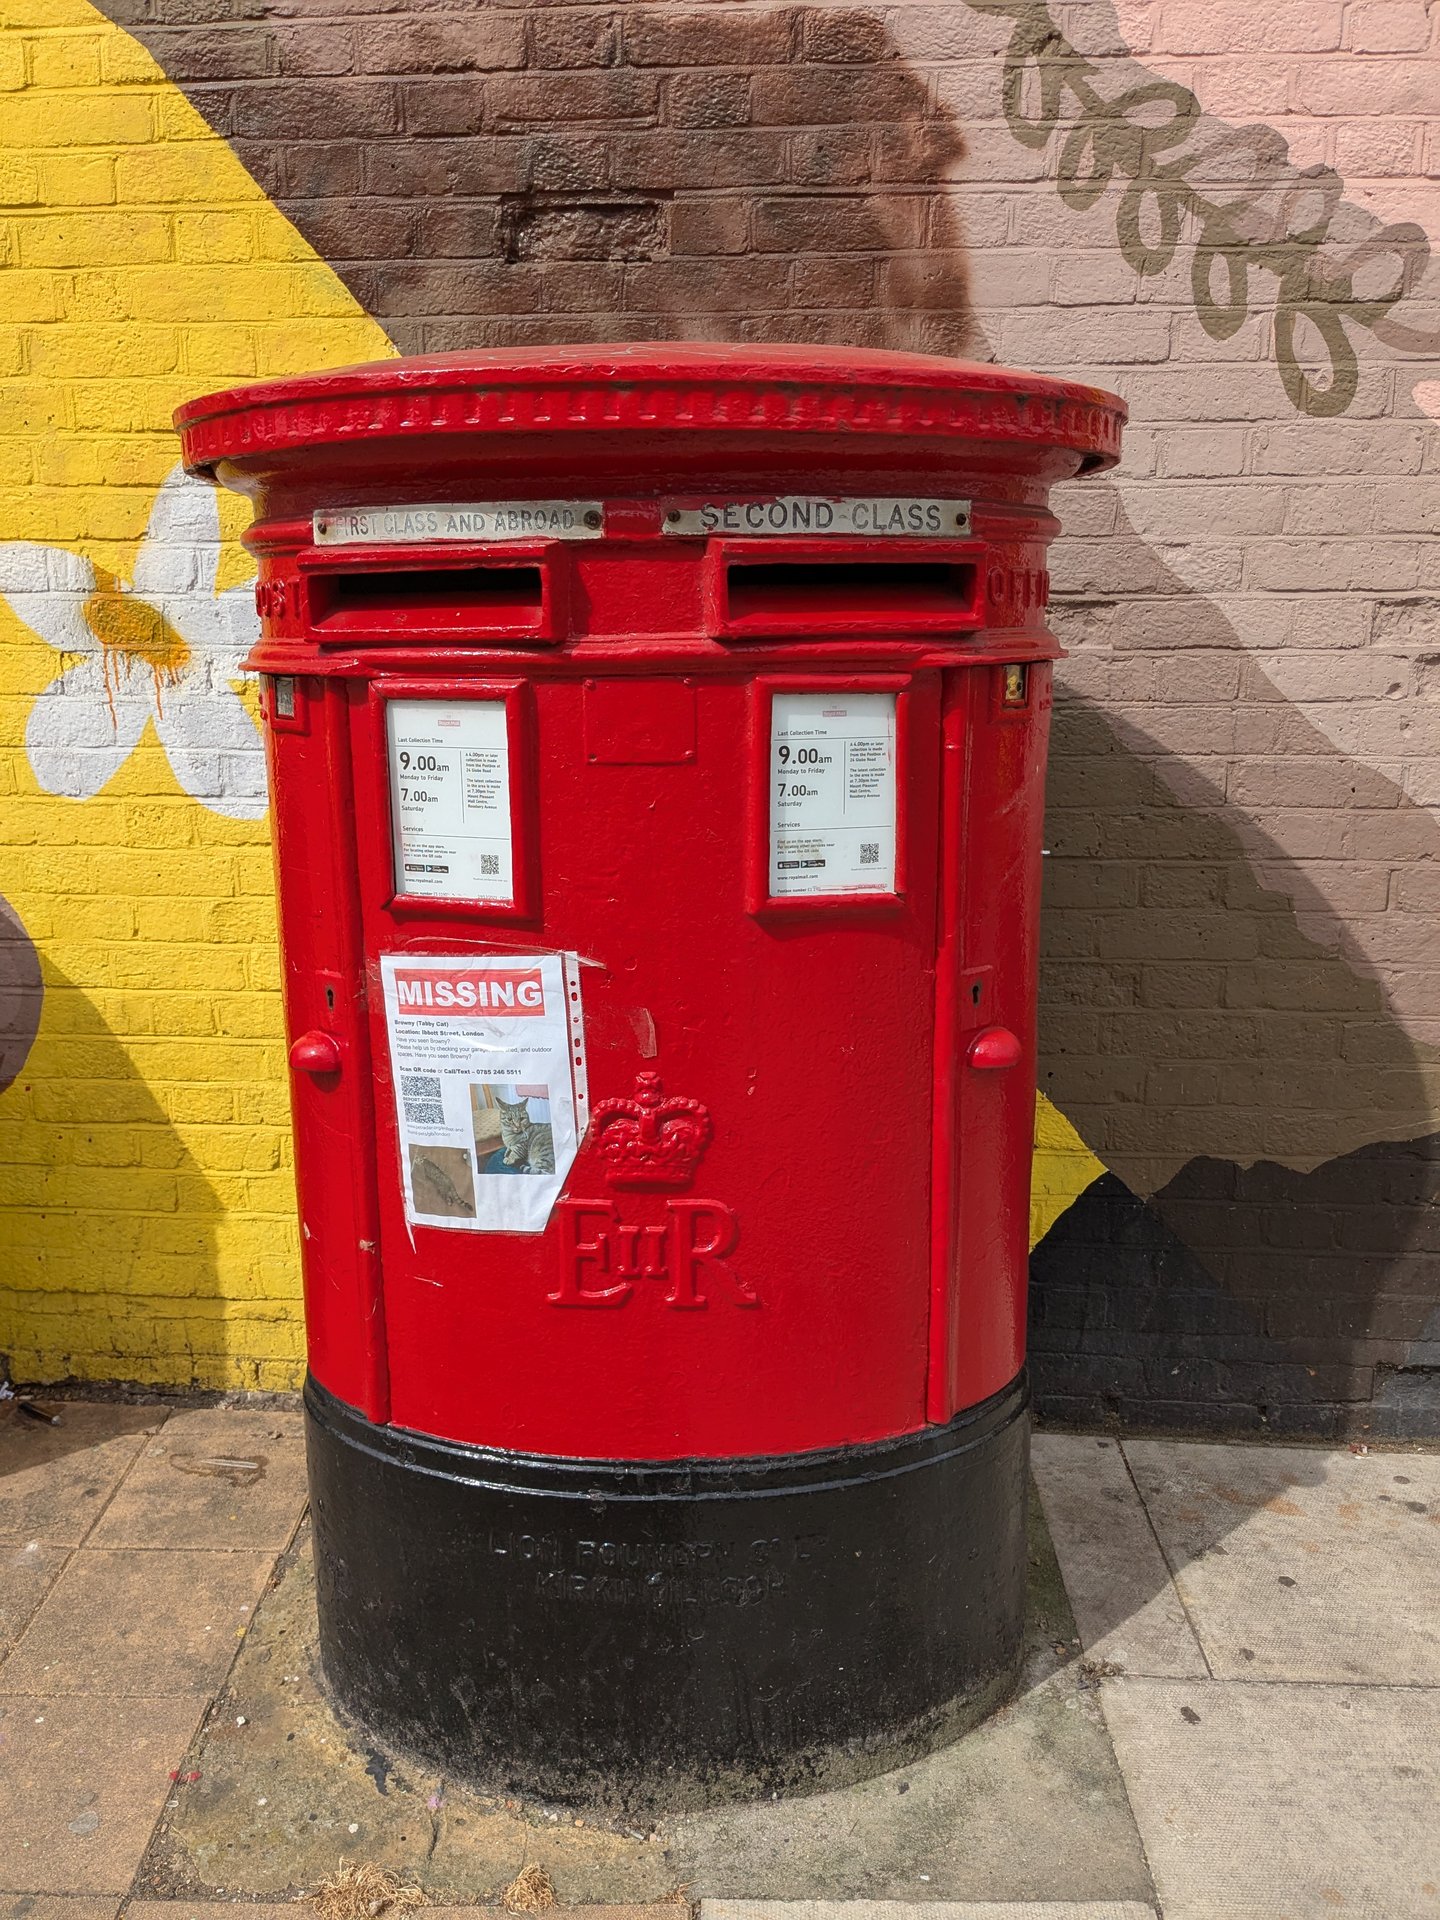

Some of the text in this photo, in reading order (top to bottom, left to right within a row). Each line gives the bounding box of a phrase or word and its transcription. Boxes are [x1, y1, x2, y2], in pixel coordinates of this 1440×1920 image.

[383, 512, 438, 535] CLASS
[446, 512, 486, 533] AND
[494, 508, 575, 532] ABROAD
[699, 501, 942, 531] SECOND CLASS
[399, 751, 450, 772] 9.00am
[778, 745, 833, 765] 9.00am
[399, 773, 420, 781] Monday
[427, 774, 444, 782] Friday
[400, 787, 439, 803] 7.00am
[777, 783, 818, 797] 7.00am
[401, 805, 424, 813] Saturday
[777, 800, 802, 808] Saturday
[397, 980, 543, 1008] MISSING
